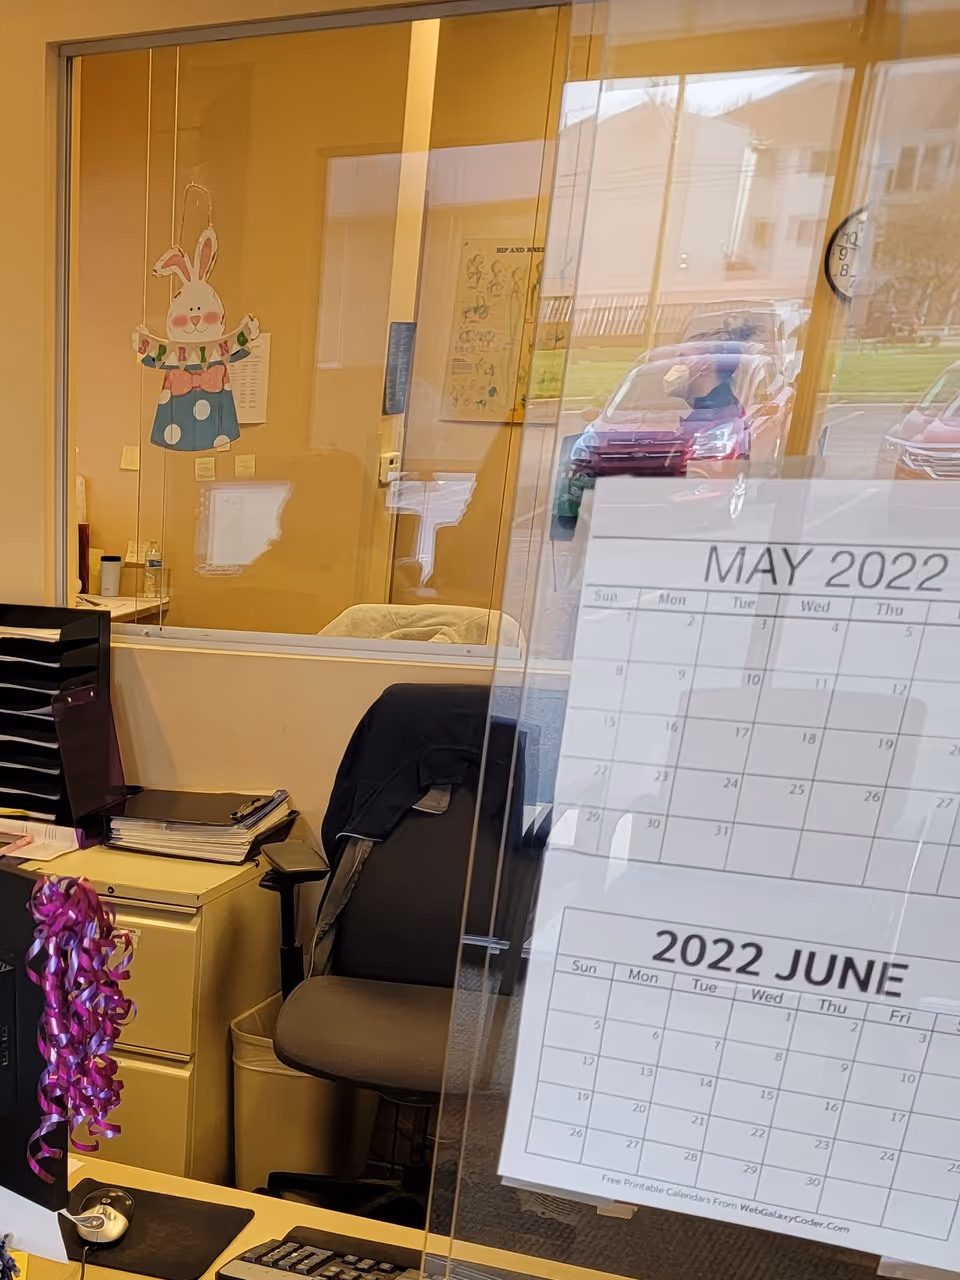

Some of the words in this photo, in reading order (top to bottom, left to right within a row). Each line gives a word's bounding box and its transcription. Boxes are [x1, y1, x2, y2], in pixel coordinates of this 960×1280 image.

[839, 248, 848, 261] 9
[840, 264, 849, 276] 8
[704, 545, 814, 586] MAY
[825, 551, 949, 592] 2022
[594, 589, 618, 602] Sun
[658, 593, 686, 606] Mon
[732, 596, 755, 609] Tue
[801, 600, 830, 613] Wed
[876, 603, 904, 616] Thu
[687, 616, 695, 626] 2
[760, 619, 767, 630] 3
[832, 623, 839, 632] 4
[905, 626, 913, 638] 5
[678, 669, 686, 680] 9
[747, 673, 760, 686] 10
[892, 684, 907, 696] 12
[666, 721, 678, 733] 16
[735, 727, 750, 738] 17
[802, 733, 816, 744] 18
[878, 739, 894, 750] 19
[654, 770, 668, 782] 23
[723, 778, 738, 788] 24
[789, 784, 804, 795] 25
[864, 791, 881, 802] 26
[936, 797, 954, 808] 27
[647, 818, 661, 829] 30
[715, 825, 729, 836] 31
[652, 929, 763, 977] 2022
[774, 949, 909, 998] JUNE
[572, 960, 597, 974] Sun
[628, 968, 659, 984] Mon
[692, 978, 718, 993] Tue
[751, 988, 784, 1005] Wed
[818, 999, 847, 1014] Thu
[889, 1009, 912, 1024] Fri
[785, 1012, 791, 1021] 1
[850, 1022, 858, 1032] 2
[918, 1033, 927, 1043] 3
[593, 1020, 601, 1030] 5
[652, 1031, 659, 1039] 6
[714, 1041, 721, 1049] 7
[775, 1052, 782, 1061] 8
[840, 1063, 848, 1073] 9
[900, 1073, 916, 1083] 10
[582, 1056, 595, 1066] 12
[640, 1067, 653, 1077] 13
[699, 1077, 712, 1088] 14
[760, 1090, 774, 1100] 15
[825, 1102, 839, 1112] 16
[891, 1112, 906, 1122] 17
[576, 1092, 590, 1101] 19
[632, 1103, 646, 1113] 20
[691, 1115, 705, 1126] 21
[751, 1128, 766, 1138] 22
[814, 1139, 830, 1150] 23
[880, 1151, 895, 1161] 24
[569, 1128, 582, 1137] 26
[626, 1140, 640, 1149] 27
[684, 1152, 698, 1161] 28
[743, 1164, 758, 1175] 29
[805, 1176, 821, 1187] 30
[601, 1174, 622, 1186] Free
[624, 1178, 664, 1194] Printable
[666, 1187, 711, 1204] Calendars
[712, 1198, 738, 1210] From
